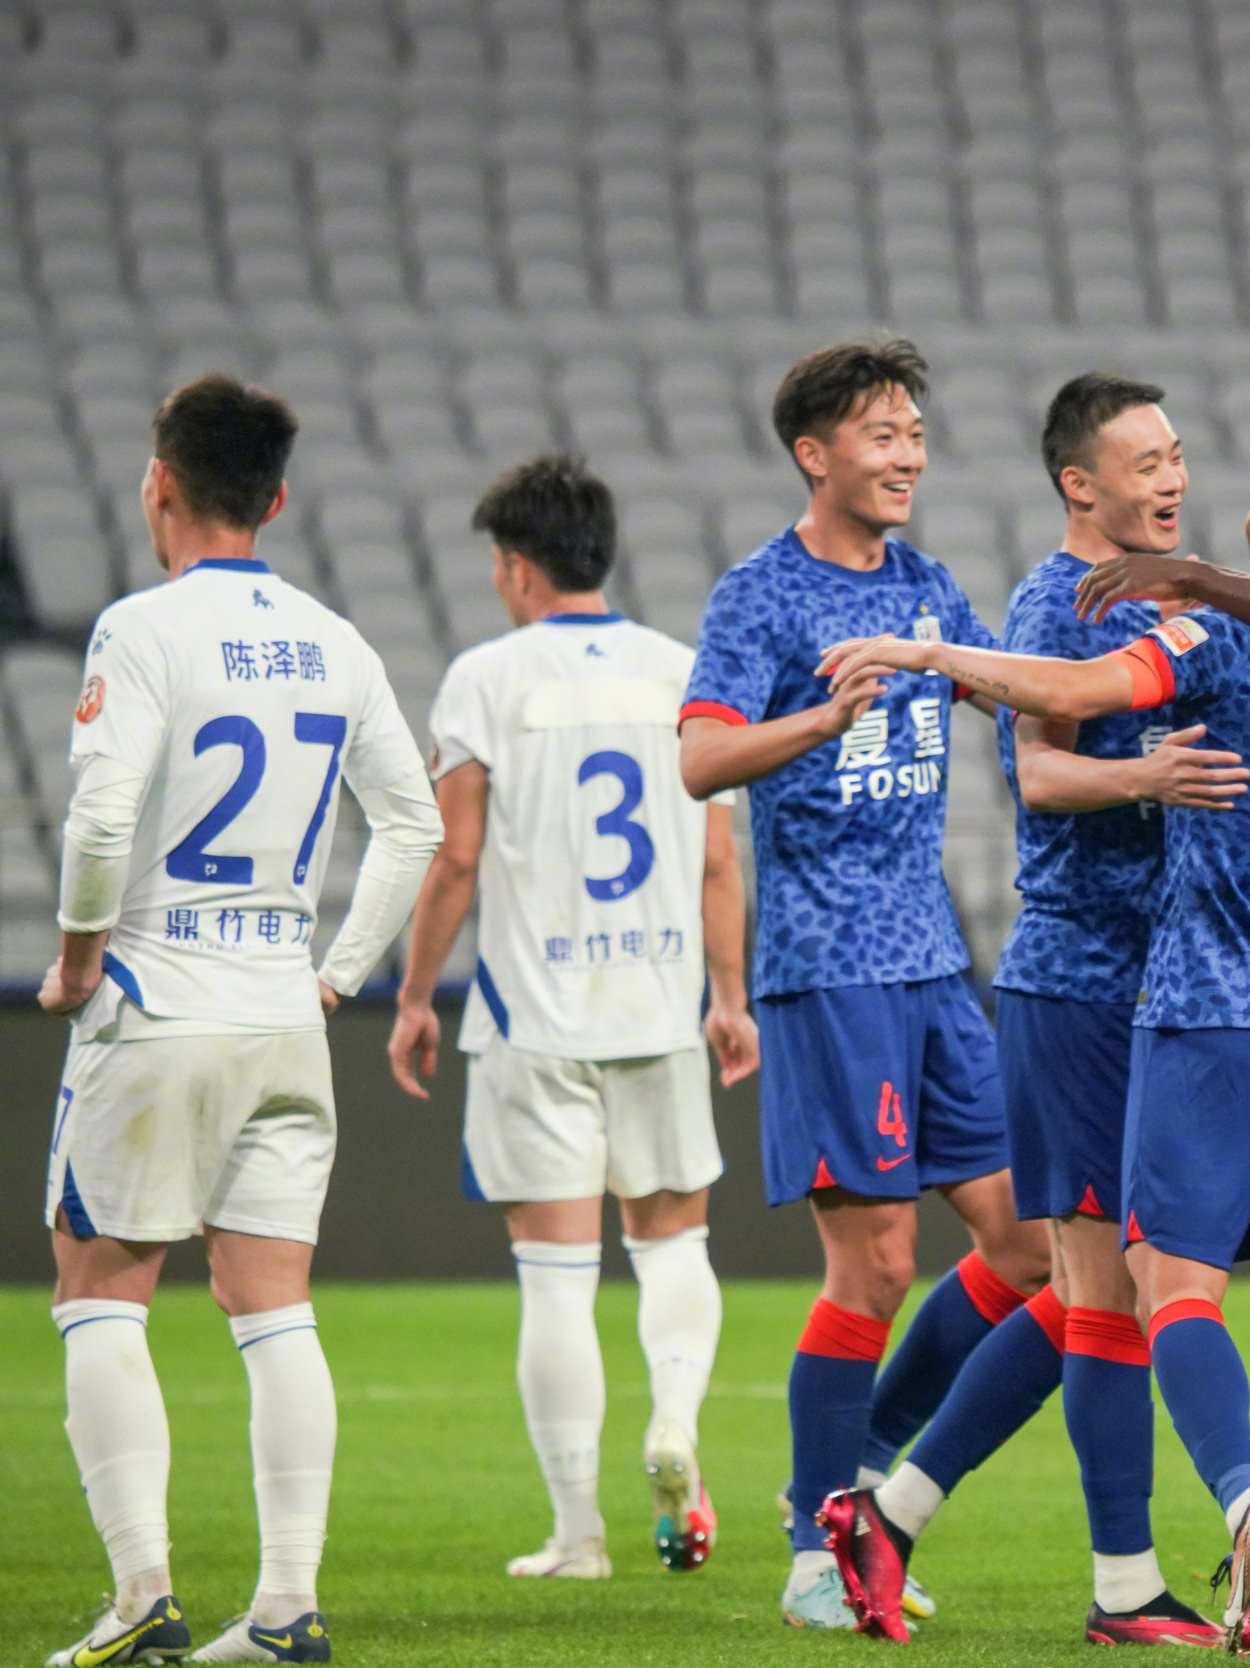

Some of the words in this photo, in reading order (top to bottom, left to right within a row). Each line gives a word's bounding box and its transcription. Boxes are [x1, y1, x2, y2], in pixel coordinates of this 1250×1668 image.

[222, 640, 326, 682] 陈泽鹏
[165, 712, 348, 885] 27
[578, 751, 655, 902] 3
[165, 908, 313, 945] 鼎竹电力
[877, 1081, 908, 1148] 4
